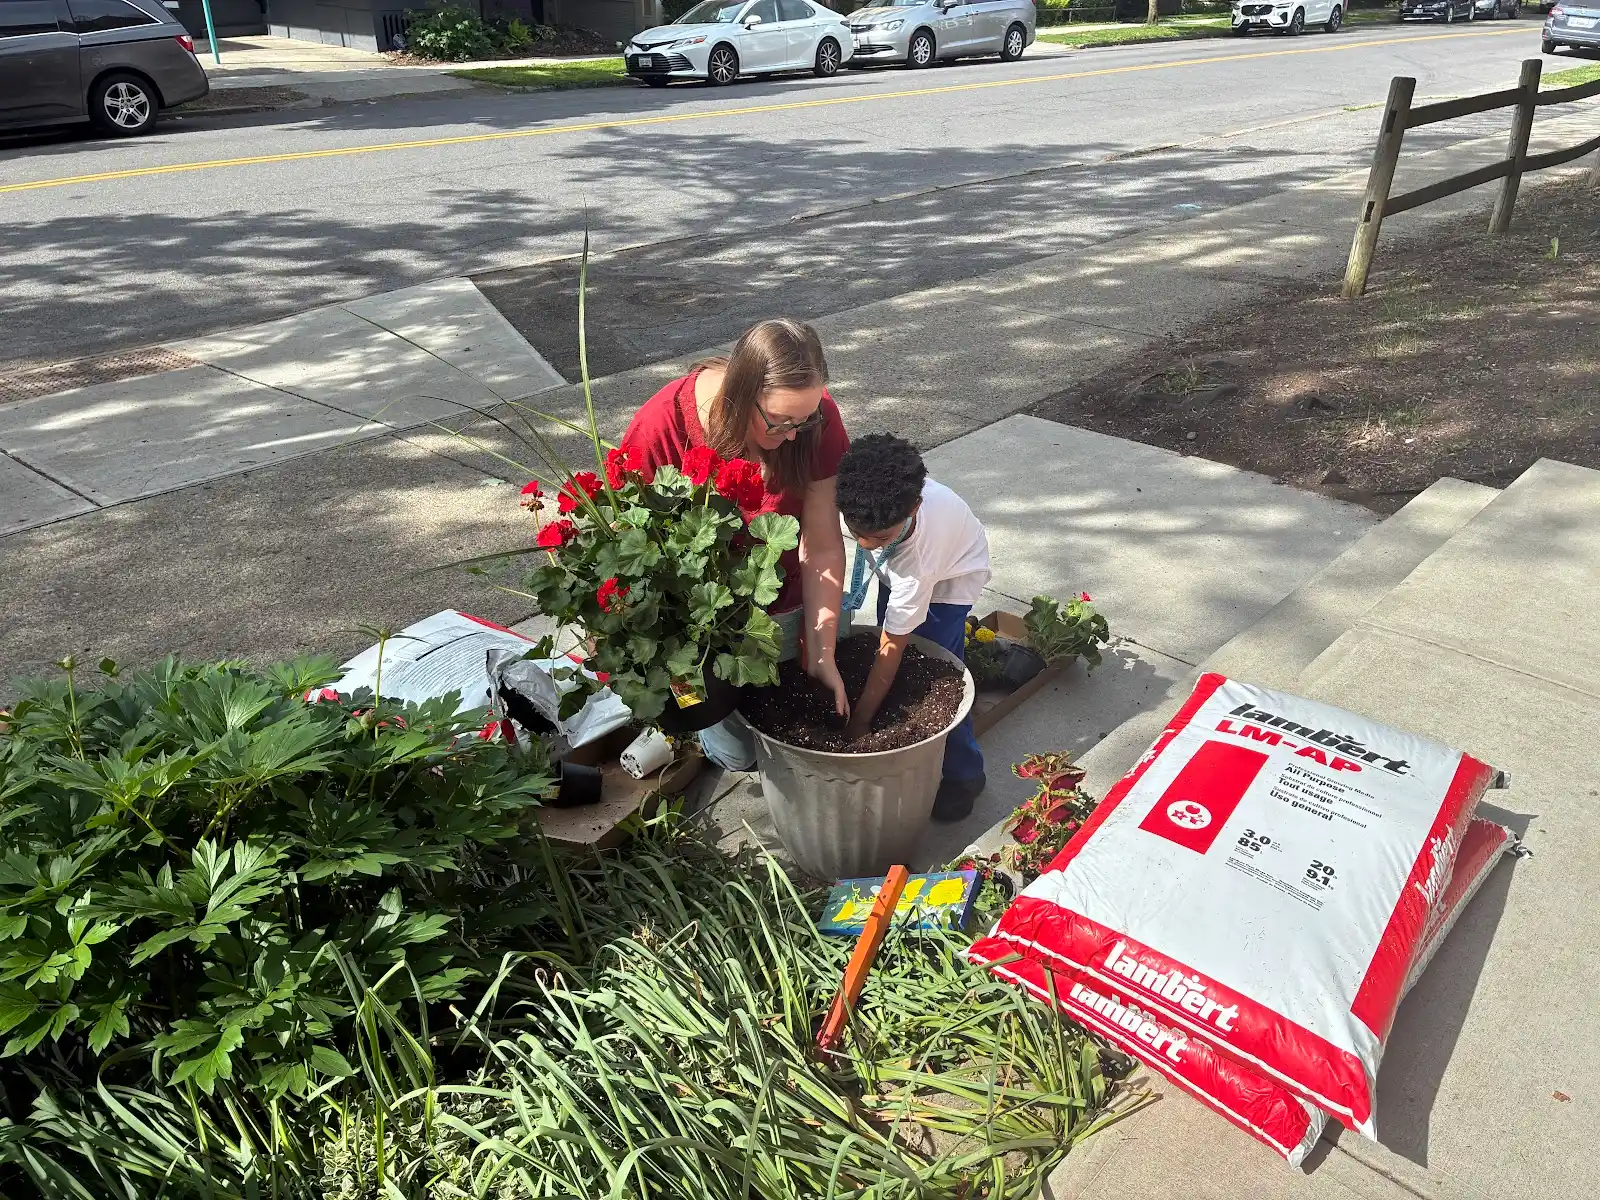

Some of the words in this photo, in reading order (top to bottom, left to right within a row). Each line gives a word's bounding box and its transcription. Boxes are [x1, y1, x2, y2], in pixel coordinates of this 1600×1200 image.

[1214, 719, 1363, 774] LM-AP
[1278, 777, 1300, 791] Tout
[1301, 787, 1334, 805] usage
[1284, 766, 1301, 776] All
[1302, 772, 1345, 794] Purpose
[1269, 789, 1290, 803] Uso
[1290, 800, 1334, 821] general
[1237, 837, 1262, 852] 85
[1243, 828, 1271, 845] 3.0
[1305, 868, 1331, 886] 9.1
[1309, 859, 1335, 876] 20
